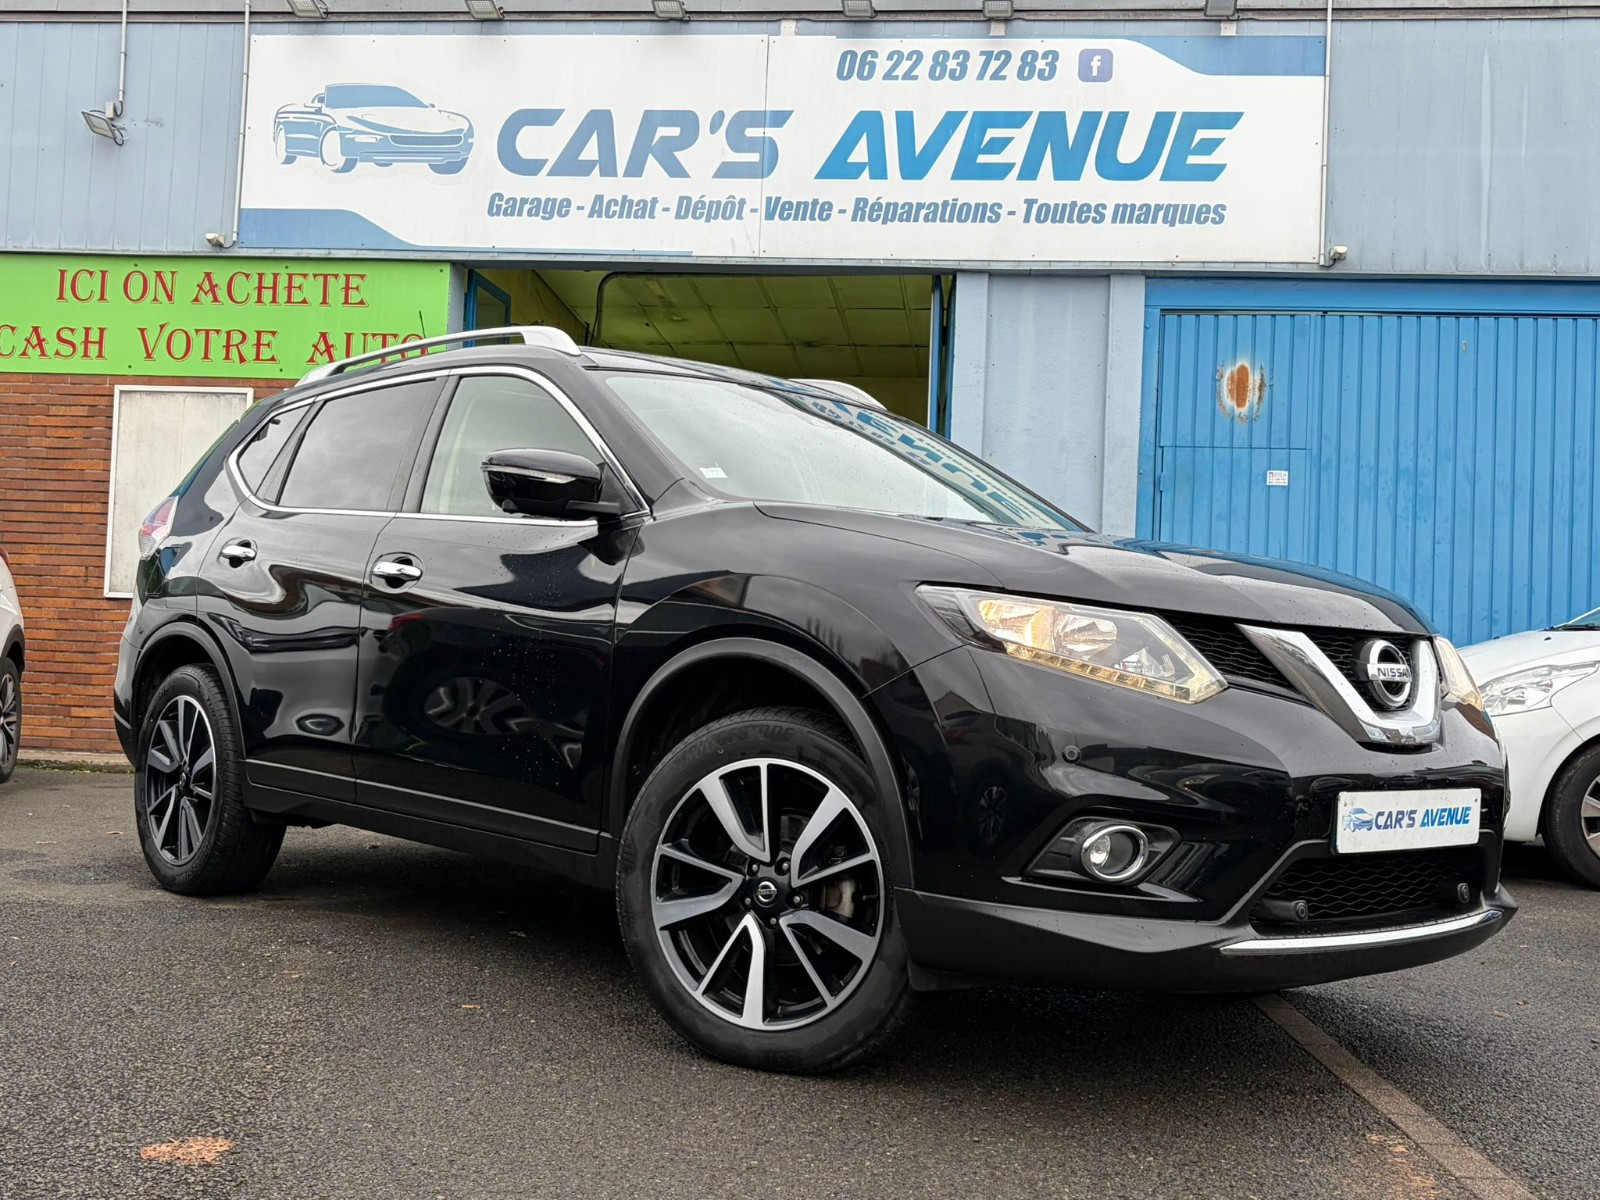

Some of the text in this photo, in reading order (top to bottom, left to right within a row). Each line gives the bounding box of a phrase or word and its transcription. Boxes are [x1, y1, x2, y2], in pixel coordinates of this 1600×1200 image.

[836, 49, 1061, 82] 06 22 83 72 83
[497, 108, 1245, 183] CAR'S AVENUE
[487, 192, 572, 221] Garage
[588, 194, 659, 220] Achat
[674, 194, 747, 223] Dépôt
[764, 196, 834, 223] Vente
[851, 197, 1003, 226] Réparations
[1022, 198, 1107, 225] Toutes
[1110, 202, 1227, 228] marques
[56, 268, 368, 308] ICI ON ACHETE
[0, 322, 430, 365] CASH VOTRE AUTO
[1374, 806, 1472, 830] CAR'S AVENUE
